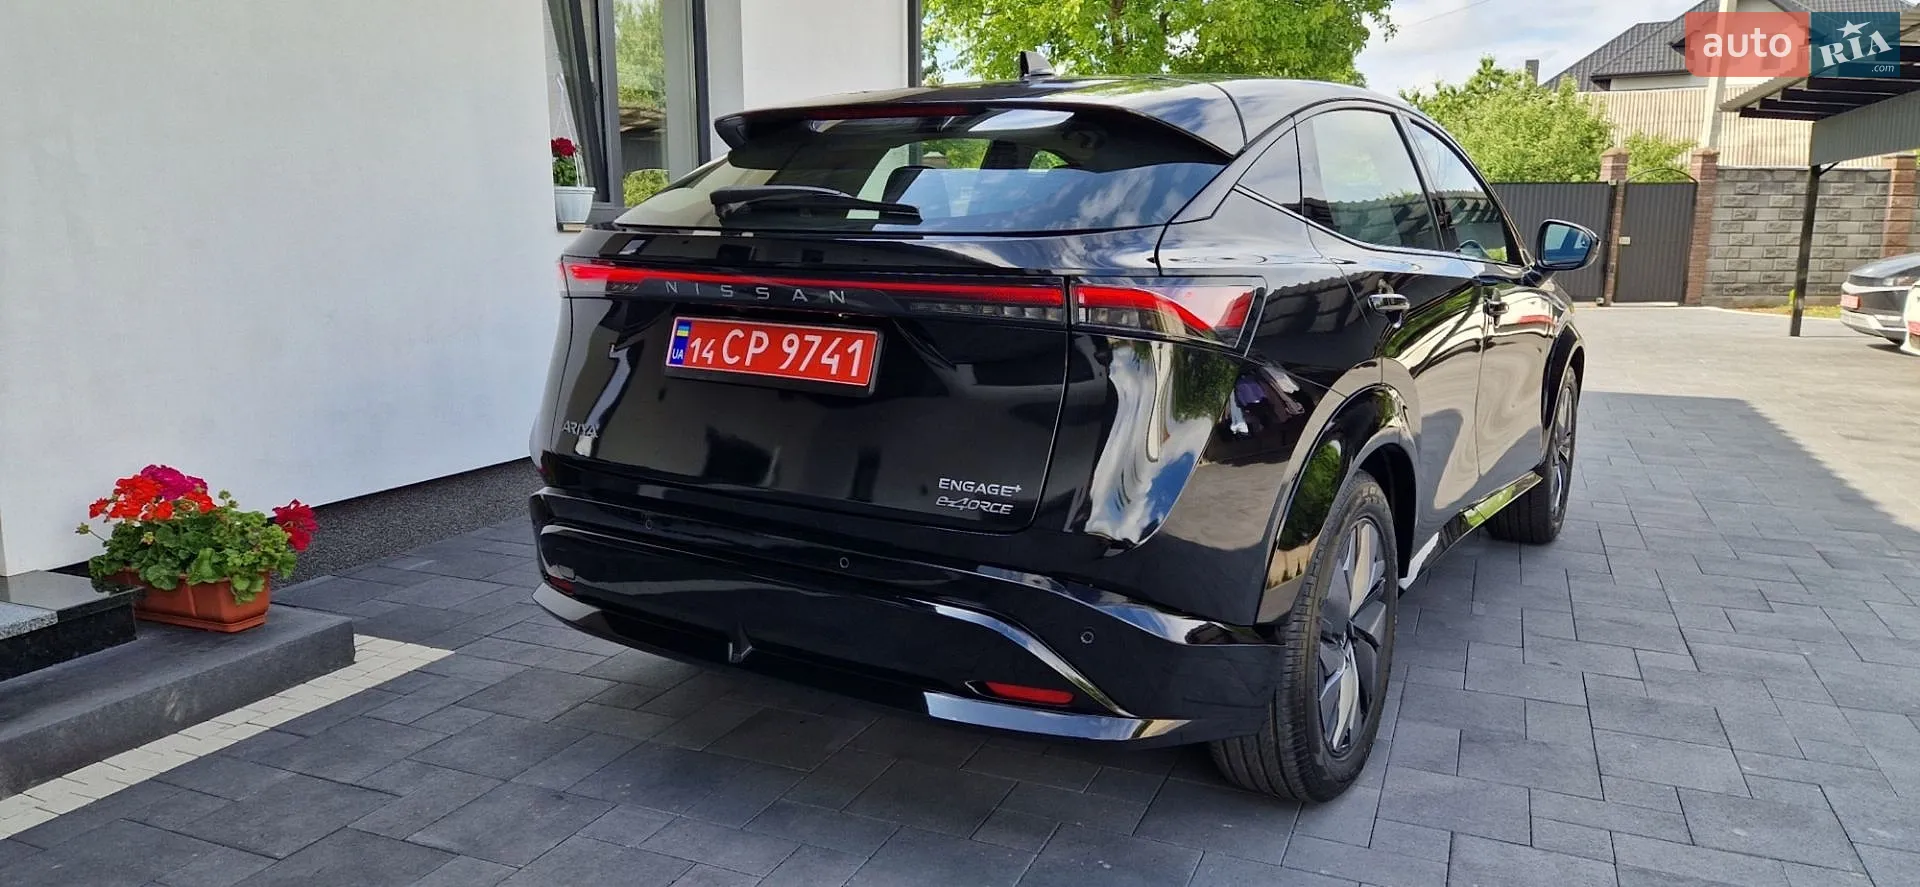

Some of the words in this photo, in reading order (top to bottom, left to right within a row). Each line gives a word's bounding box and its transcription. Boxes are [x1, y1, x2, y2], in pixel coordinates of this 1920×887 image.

[665, 281, 846, 304] NISSAN
[672, 347, 684, 360] UA
[779, 332, 865, 377] 9741
[562, 420, 599, 439] ARIYA
